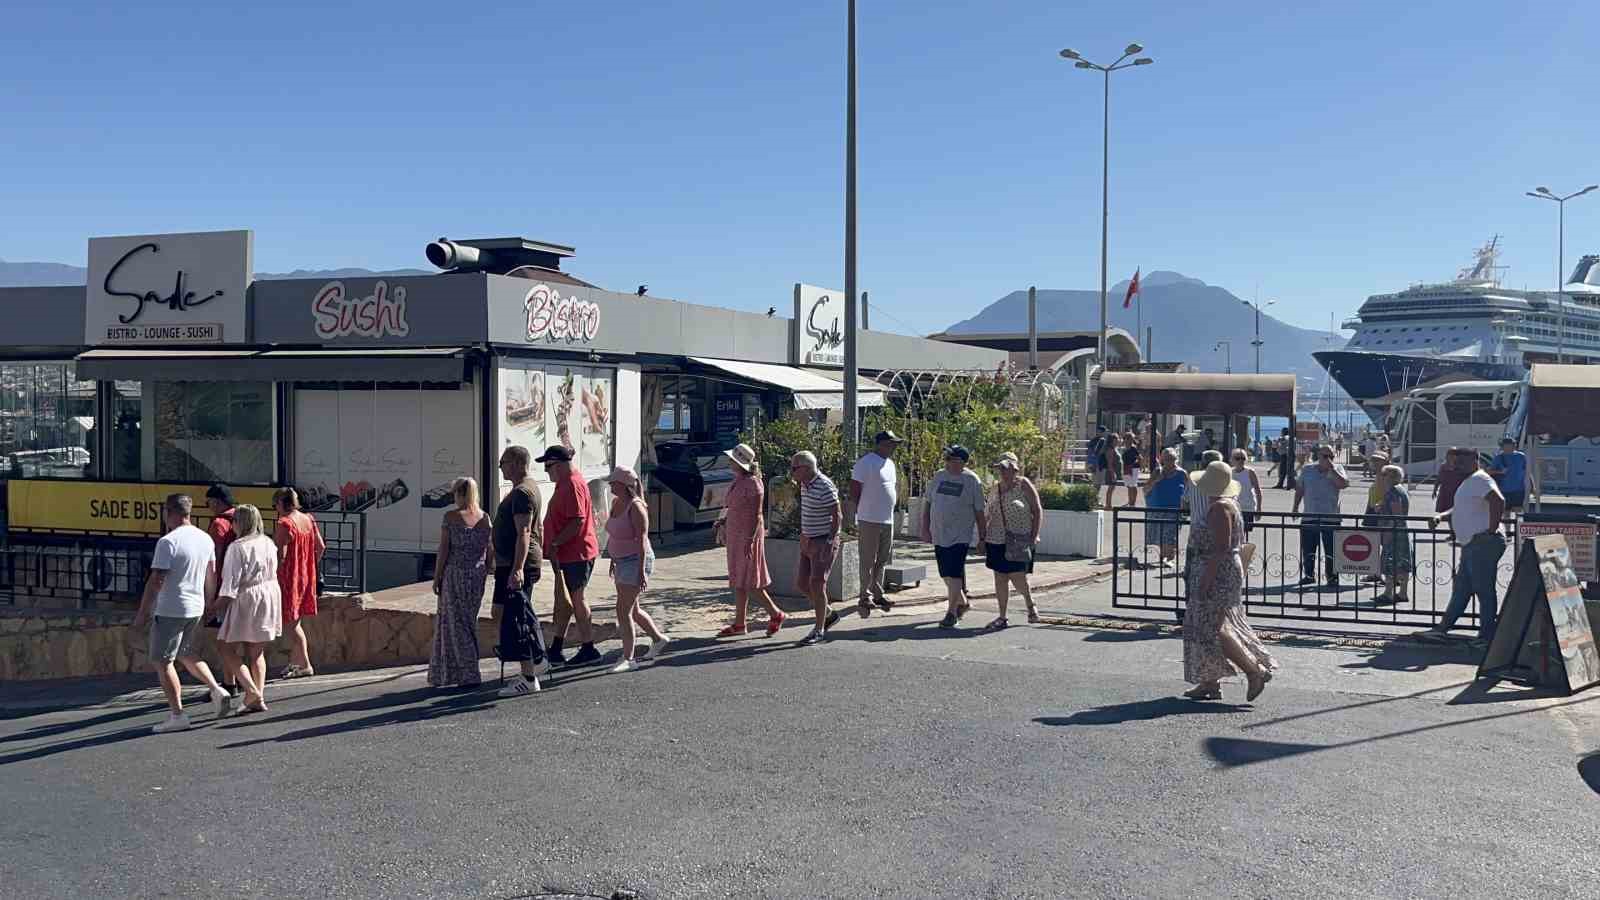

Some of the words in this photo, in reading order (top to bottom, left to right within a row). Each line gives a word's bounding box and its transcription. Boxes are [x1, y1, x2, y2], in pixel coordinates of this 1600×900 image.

[104, 243, 222, 323] Sade
[313, 282, 406, 337] Sushi
[107, 328, 138, 339] BISTRO
[144, 327, 184, 338] LOUNGE
[187, 326, 213, 338] SUSHI
[525, 285, 600, 340] Bistro
[90, 499, 130, 519] SADE
